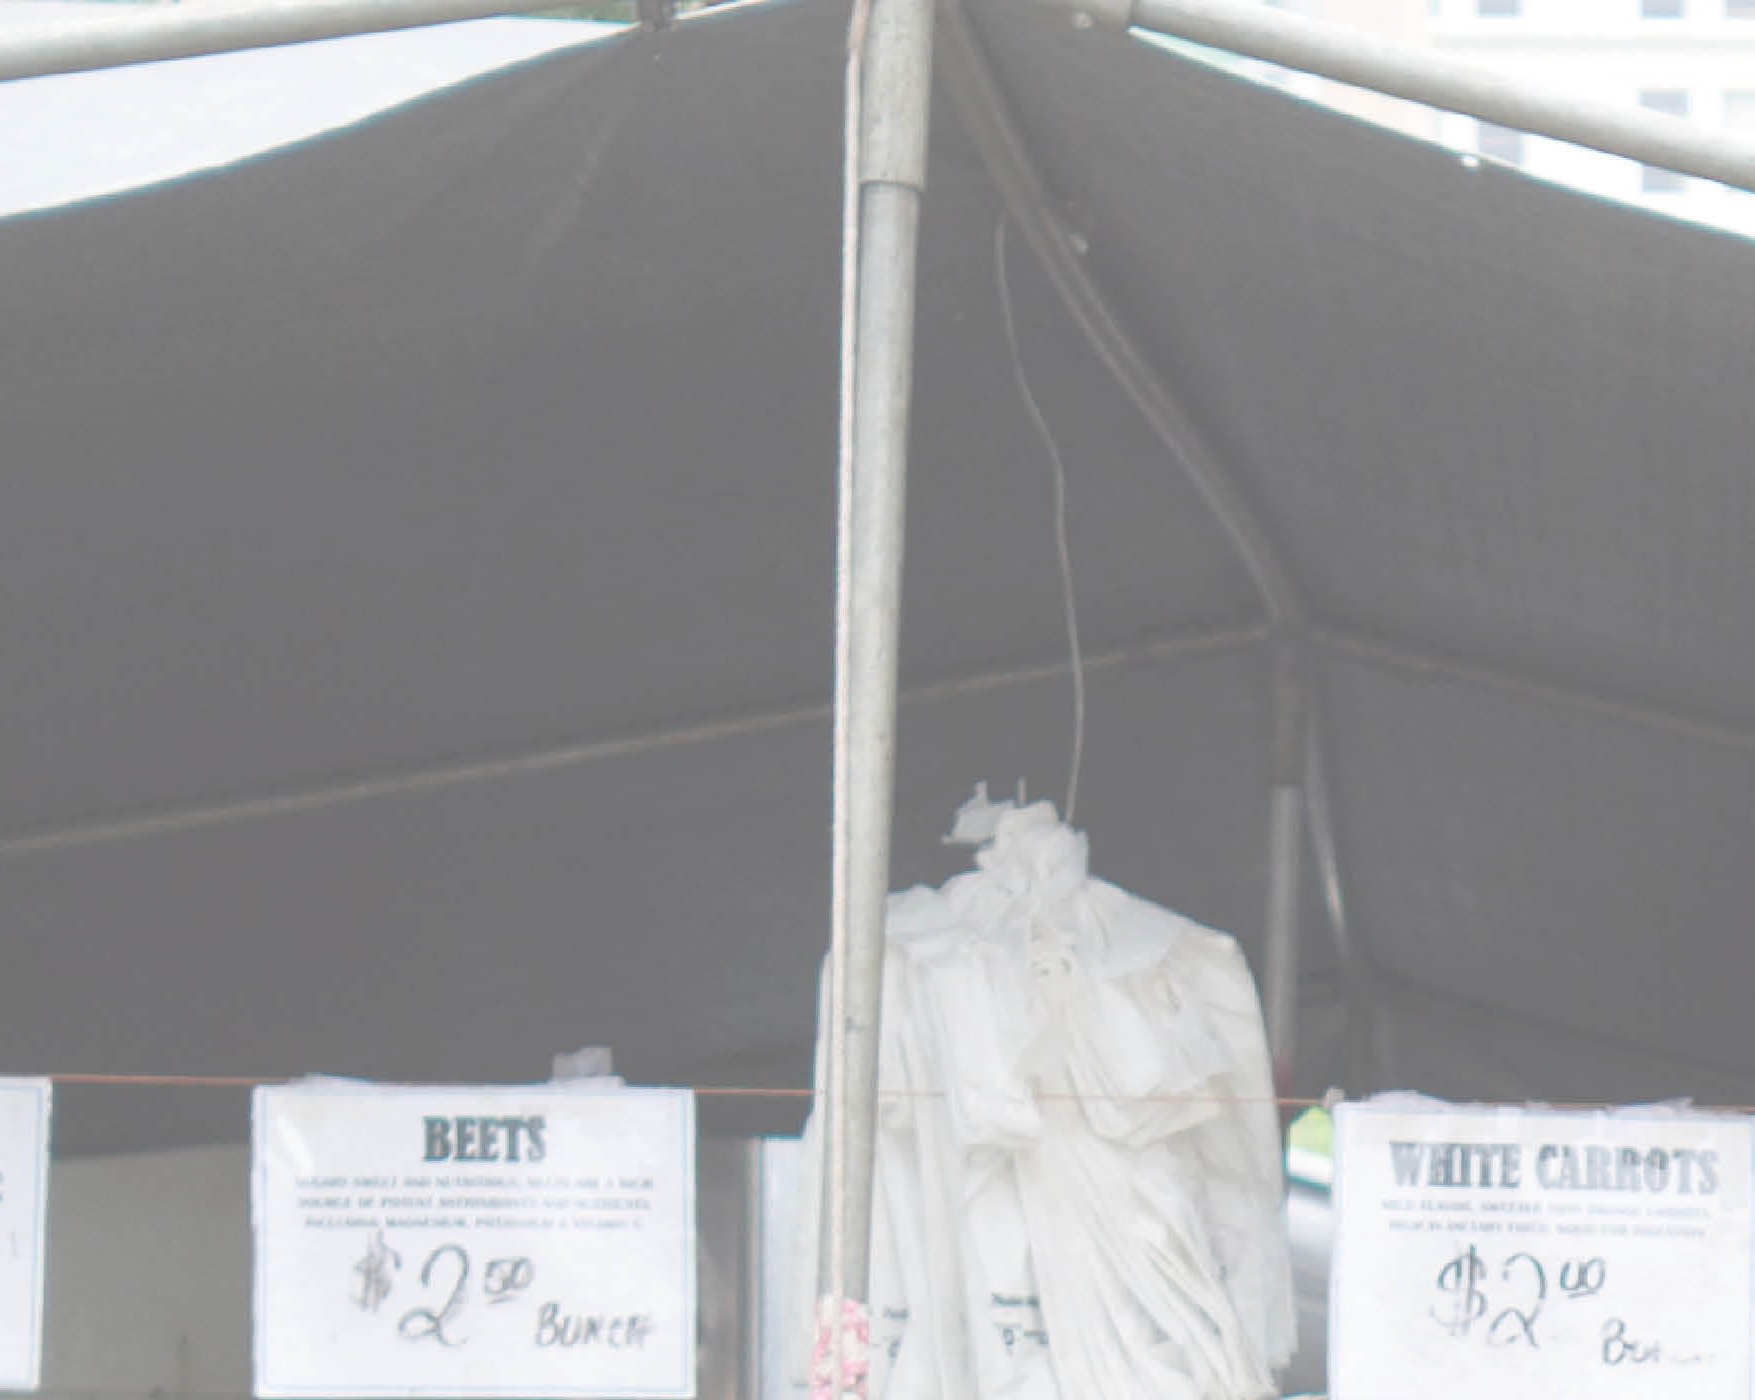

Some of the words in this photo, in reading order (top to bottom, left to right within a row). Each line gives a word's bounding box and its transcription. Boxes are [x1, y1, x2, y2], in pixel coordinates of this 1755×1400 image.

[422, 1114, 546, 1162] BEETS
[1389, 1142, 1521, 1189] WHITE
[1535, 1144, 1719, 1196] CARROTS
